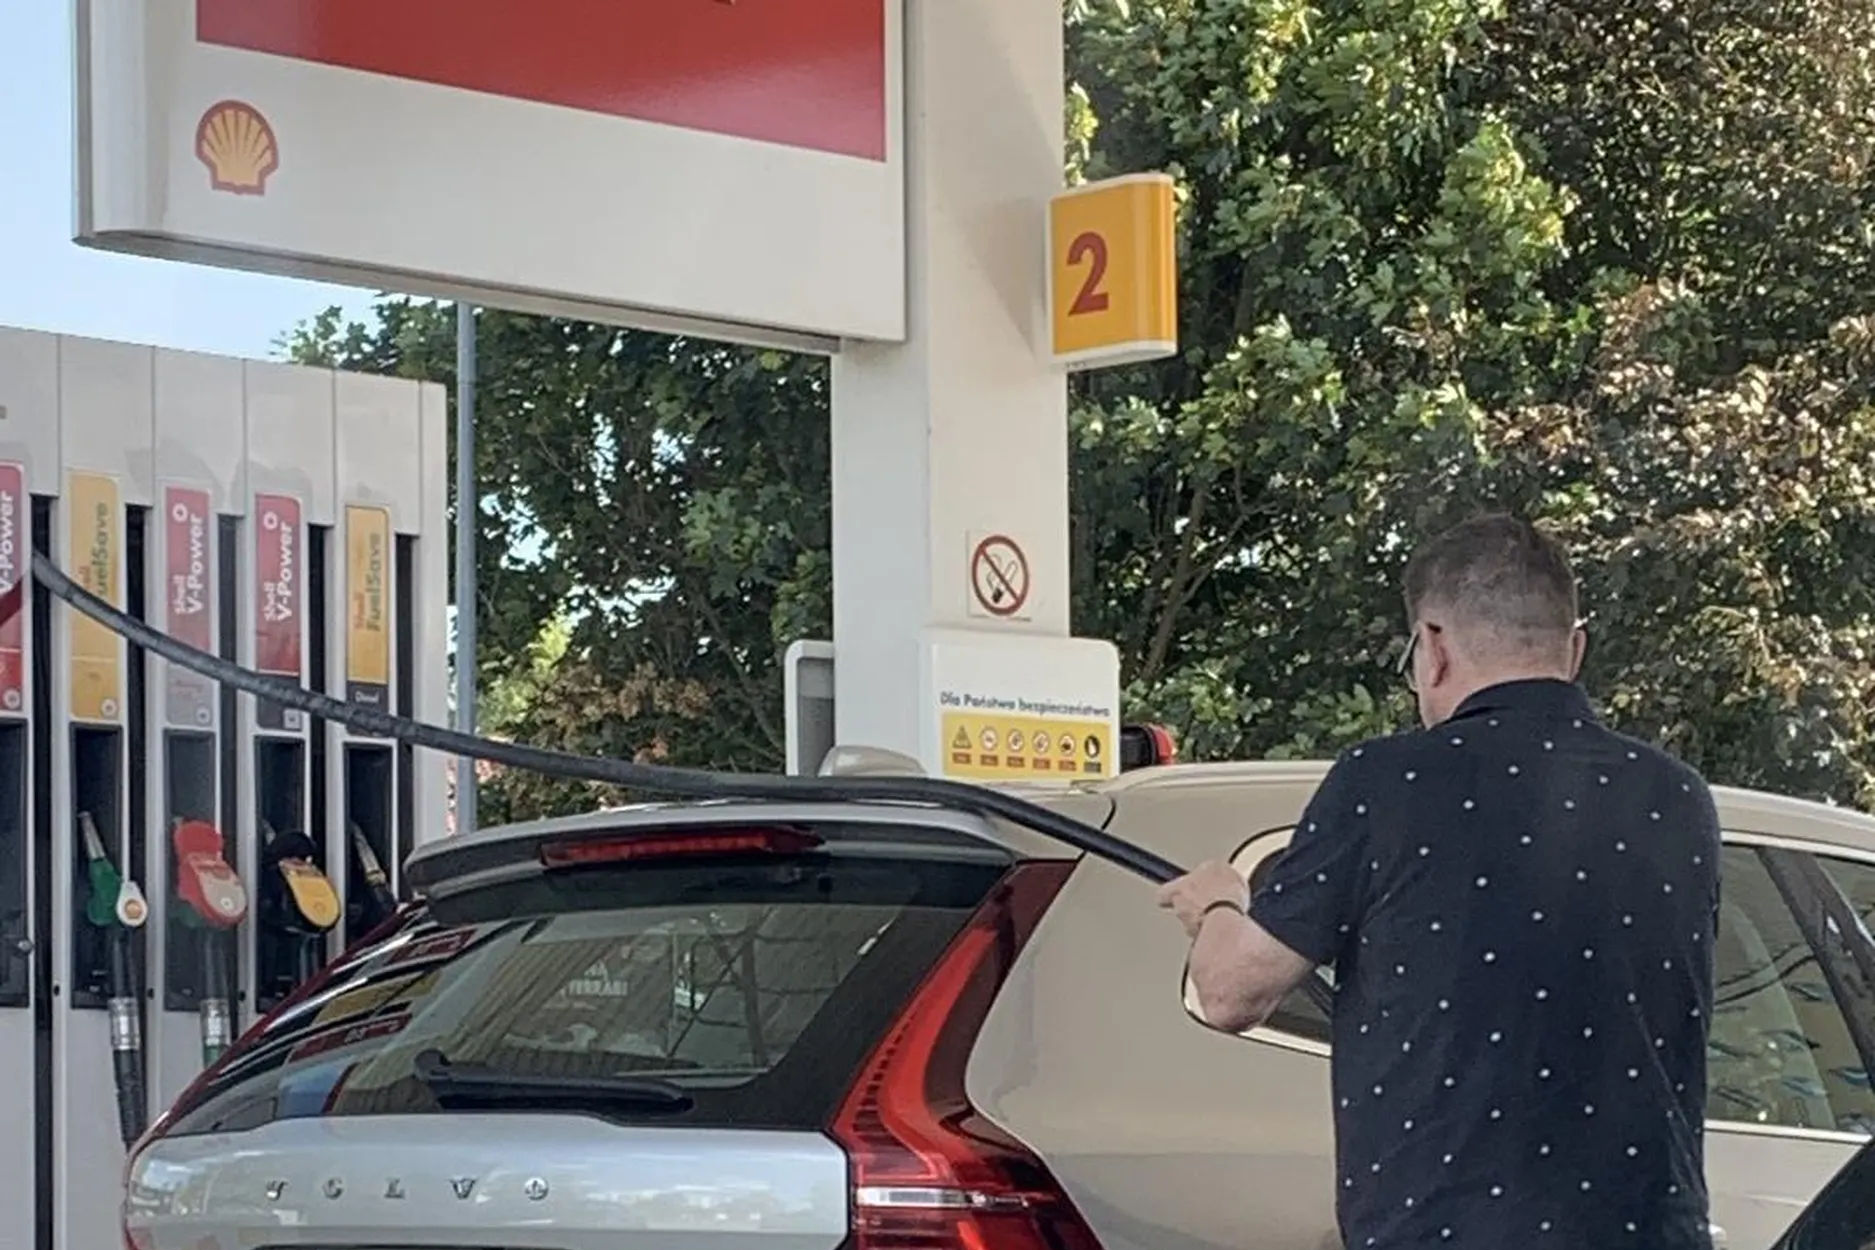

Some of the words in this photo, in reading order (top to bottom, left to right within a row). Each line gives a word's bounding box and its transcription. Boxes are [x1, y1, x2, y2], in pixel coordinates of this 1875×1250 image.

[1067, 232, 1109, 317] 2
[186, 513, 203, 614] V-Power
[277, 521, 292, 620] V-Power
[940, 691, 960, 706] Dla
[264, 1177, 549, 1201] VOLVO
